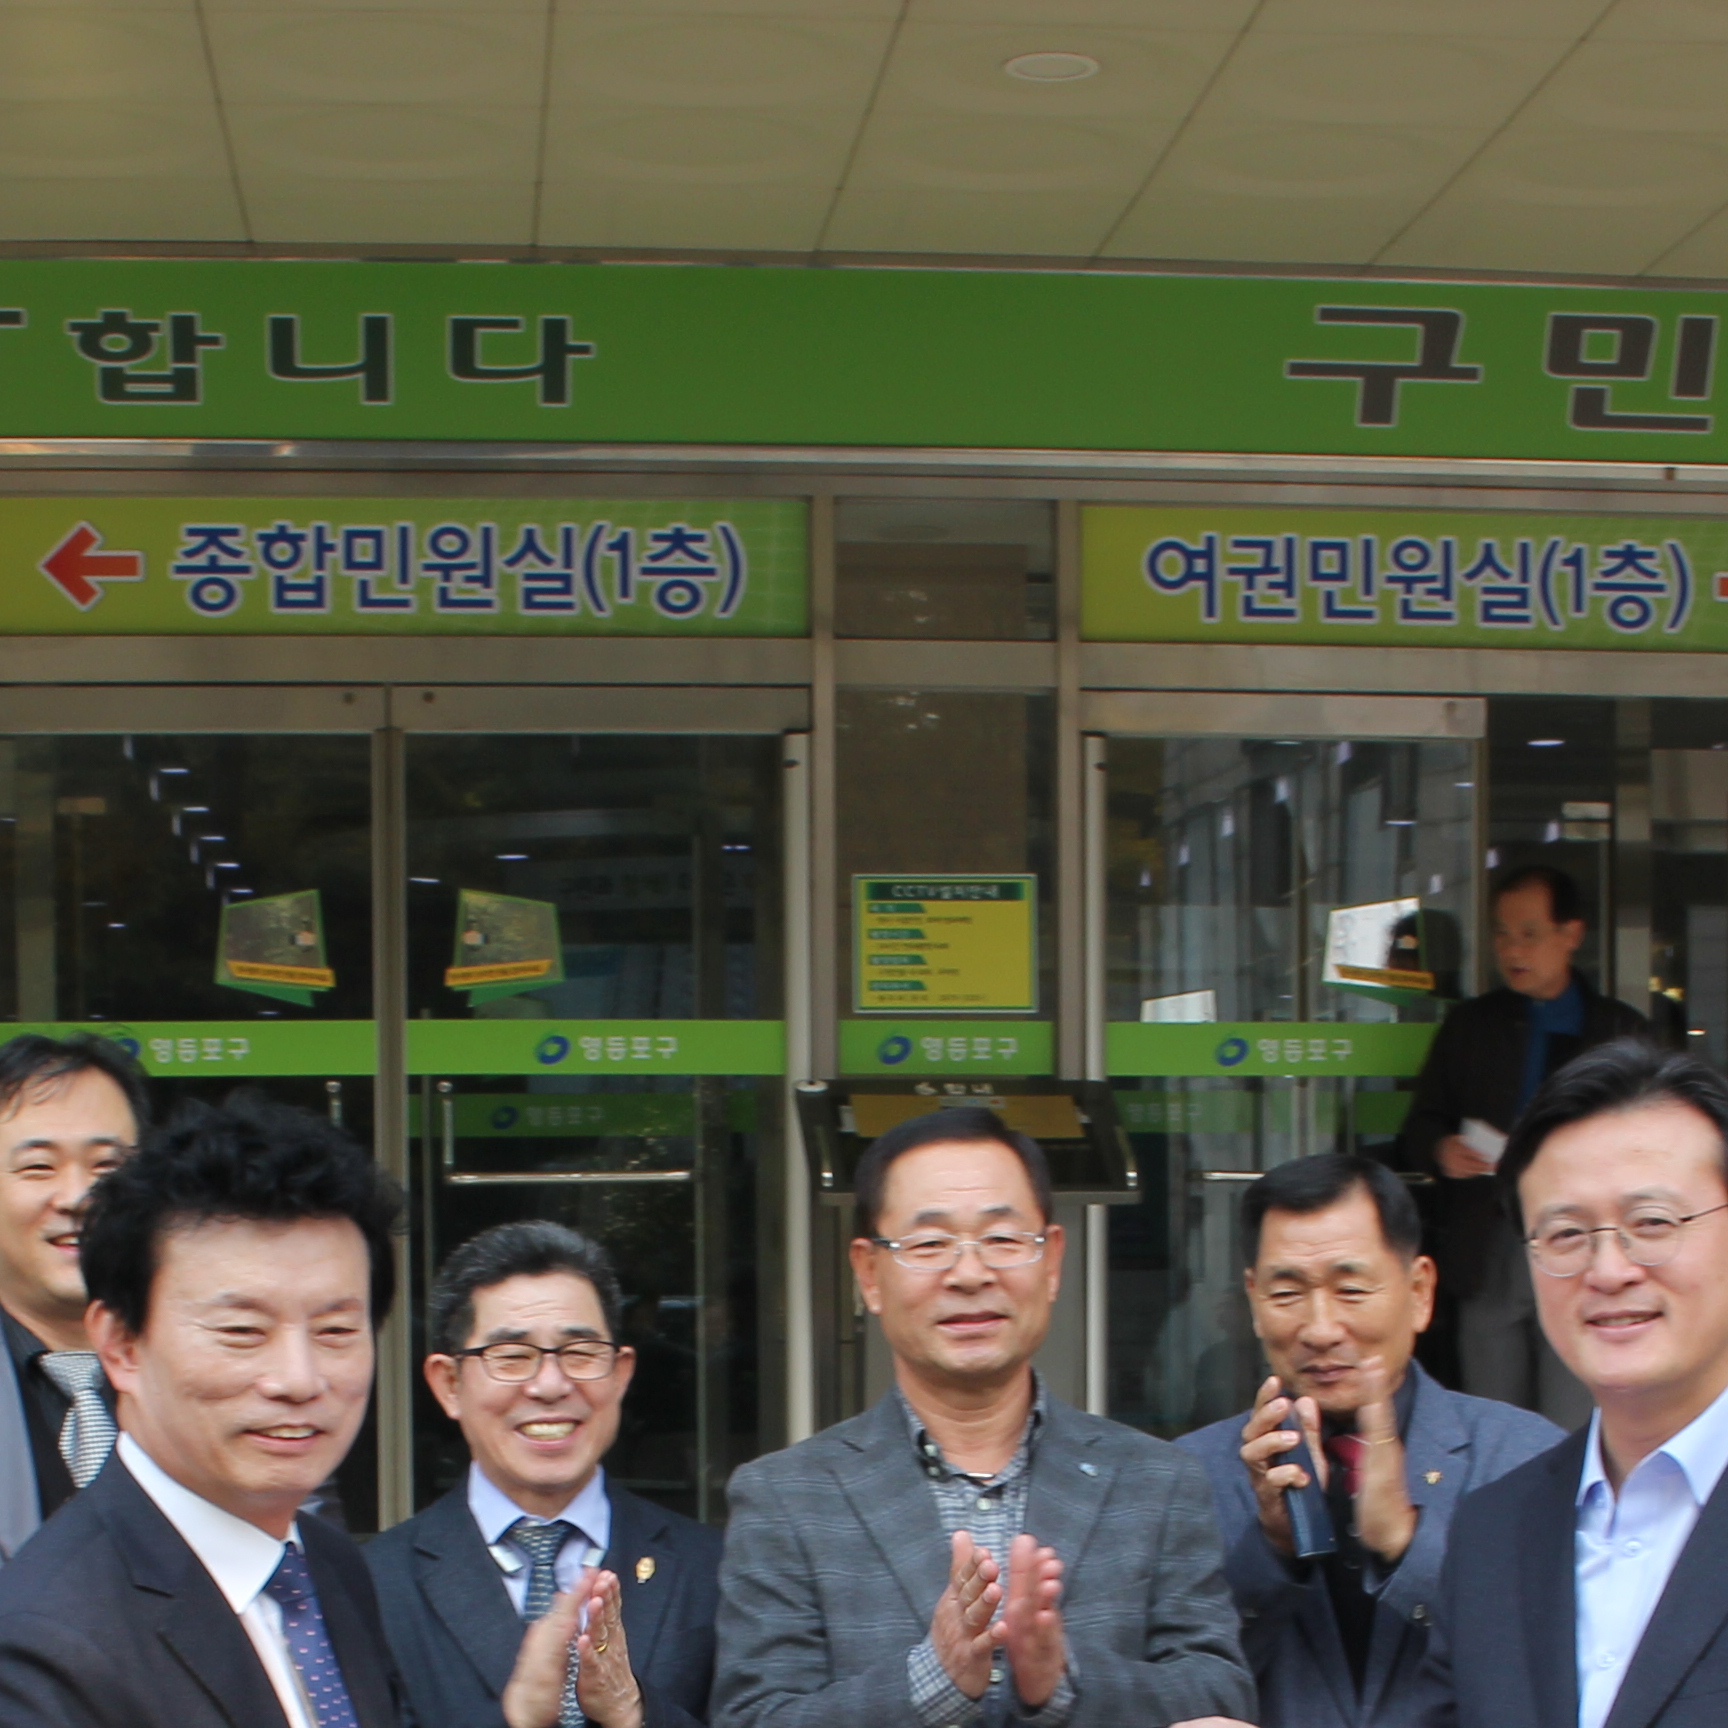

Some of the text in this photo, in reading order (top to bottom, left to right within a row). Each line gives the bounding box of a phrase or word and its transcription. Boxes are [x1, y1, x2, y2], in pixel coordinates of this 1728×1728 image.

[1283, 304, 1720, 434] 구민
[172, 522, 746, 619] 종합민원실(1층)
[1145, 532, 1693, 633] 여권민원실(1층)
[149, 1036, 250, 1064] 영등포구
[580, 1034, 678, 1061] 영등포구
[921, 1035, 1019, 1063] 영등포구
[1257, 1037, 1354, 1065] 영등포구
